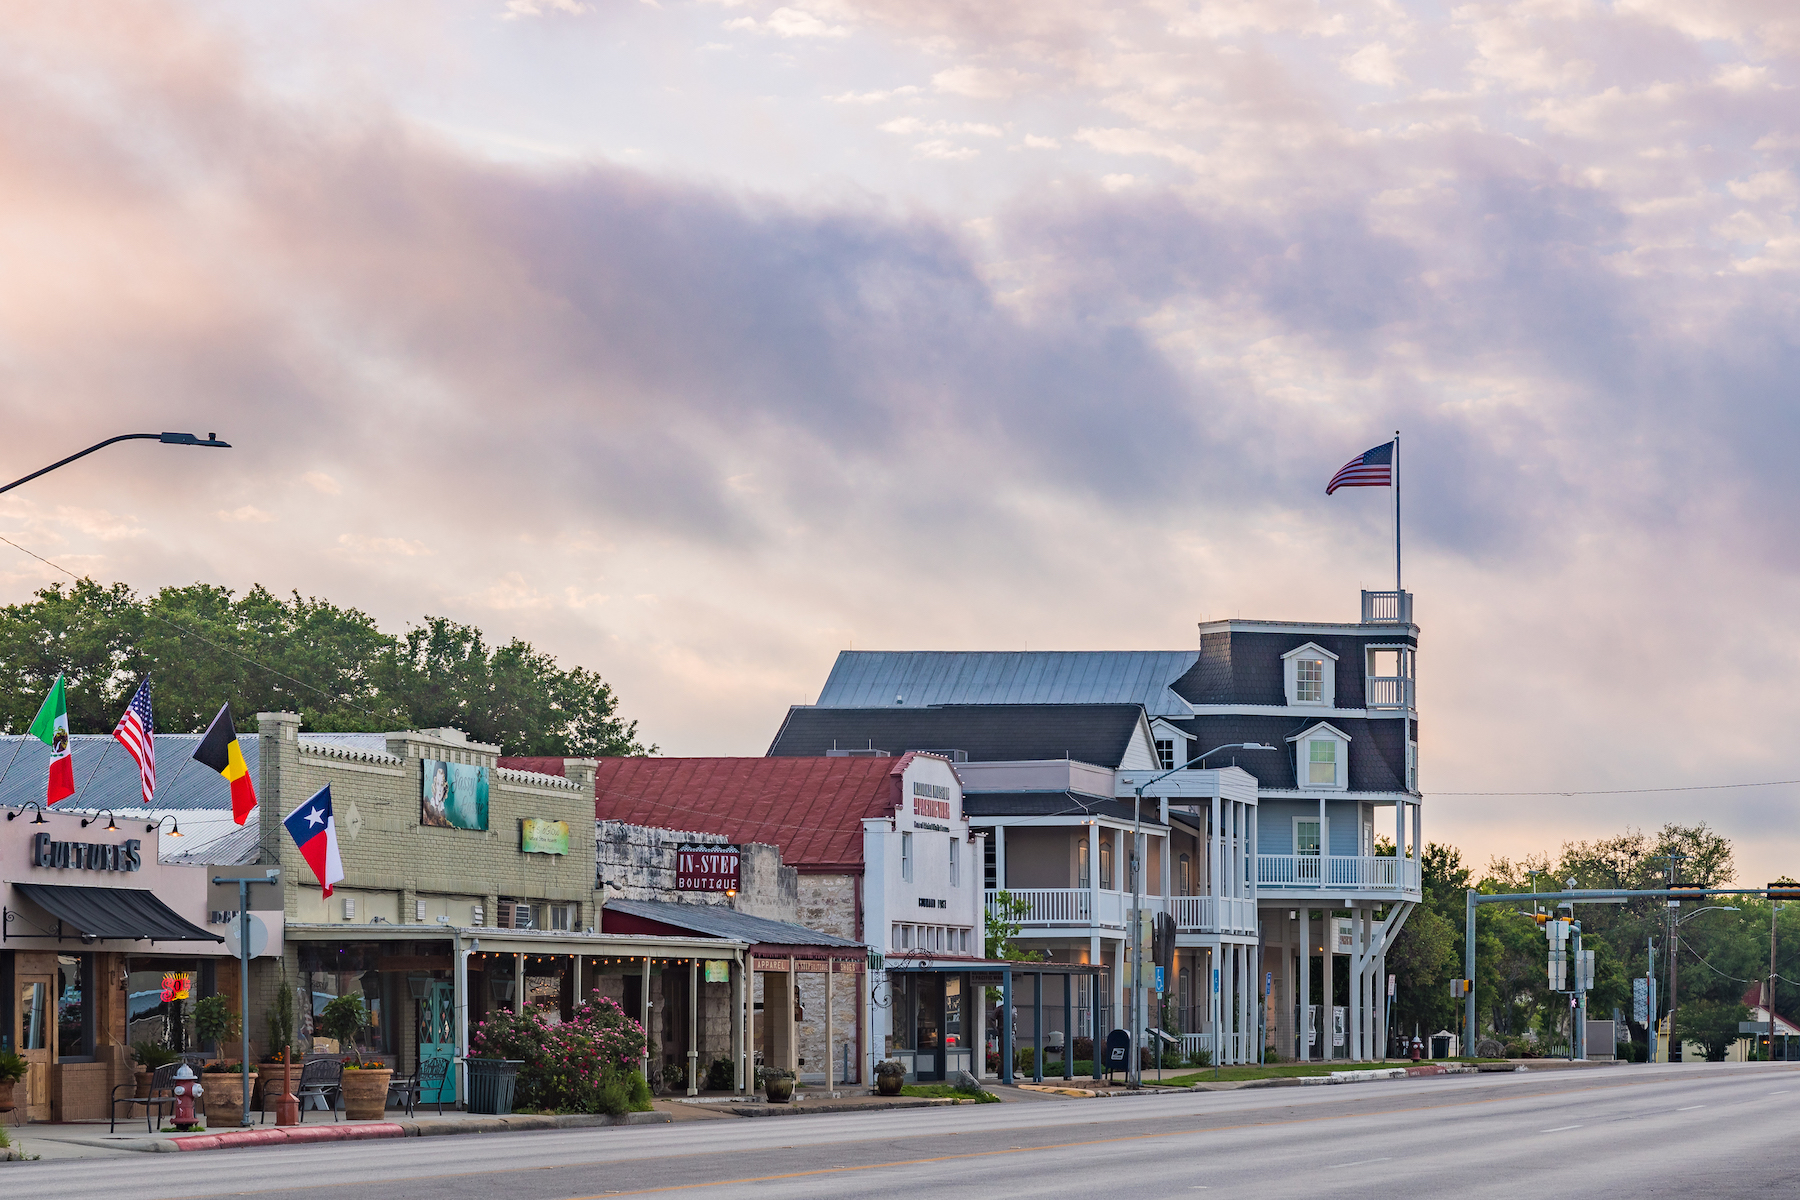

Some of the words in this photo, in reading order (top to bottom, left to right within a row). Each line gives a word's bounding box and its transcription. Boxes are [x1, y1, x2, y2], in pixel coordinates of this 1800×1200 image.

[450, 768, 477, 798] Sassy
[679, 854, 739, 875] IN-STEP
[678, 877, 737, 890] BOUTIQUE
[757, 960, 785, 970] APPAREL
[840, 962, 856, 972] SHOES
